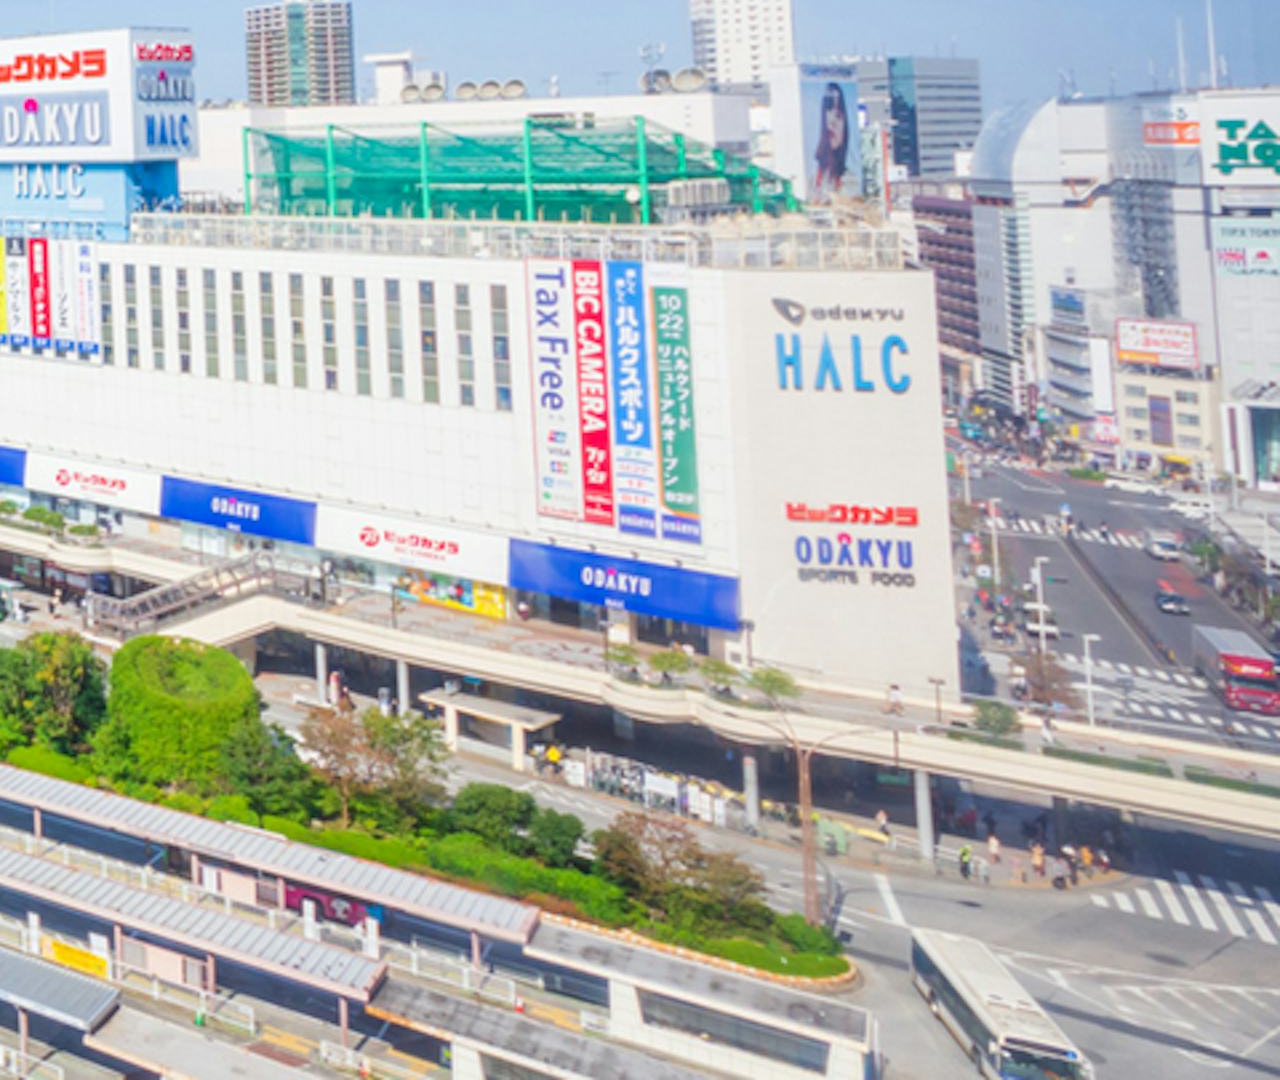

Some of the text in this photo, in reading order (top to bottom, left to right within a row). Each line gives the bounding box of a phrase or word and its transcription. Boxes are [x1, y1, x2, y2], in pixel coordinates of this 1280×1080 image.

[136, 43, 193, 62] ビックカメラ
[145, 113, 190, 147] HALC
[13, 164, 85, 199] HALC
[810, 304, 905, 322] odakyu
[534, 268, 569, 411] Tax Free
[574, 271, 608, 433] BIC CAMERA
[615, 306, 644, 441] ハルクスポーツ
[774, 331, 911, 395] HALC
[211, 496, 260, 521] ODAKYU
[786, 502, 919, 527] ビックカメラ
[383, 530, 460, 555] ビックカメラ
[795, 533, 913, 569] ODAKYU
[580, 566, 652, 597] ODAKYU
[798, 567, 916, 588] SPORTS FOOD
